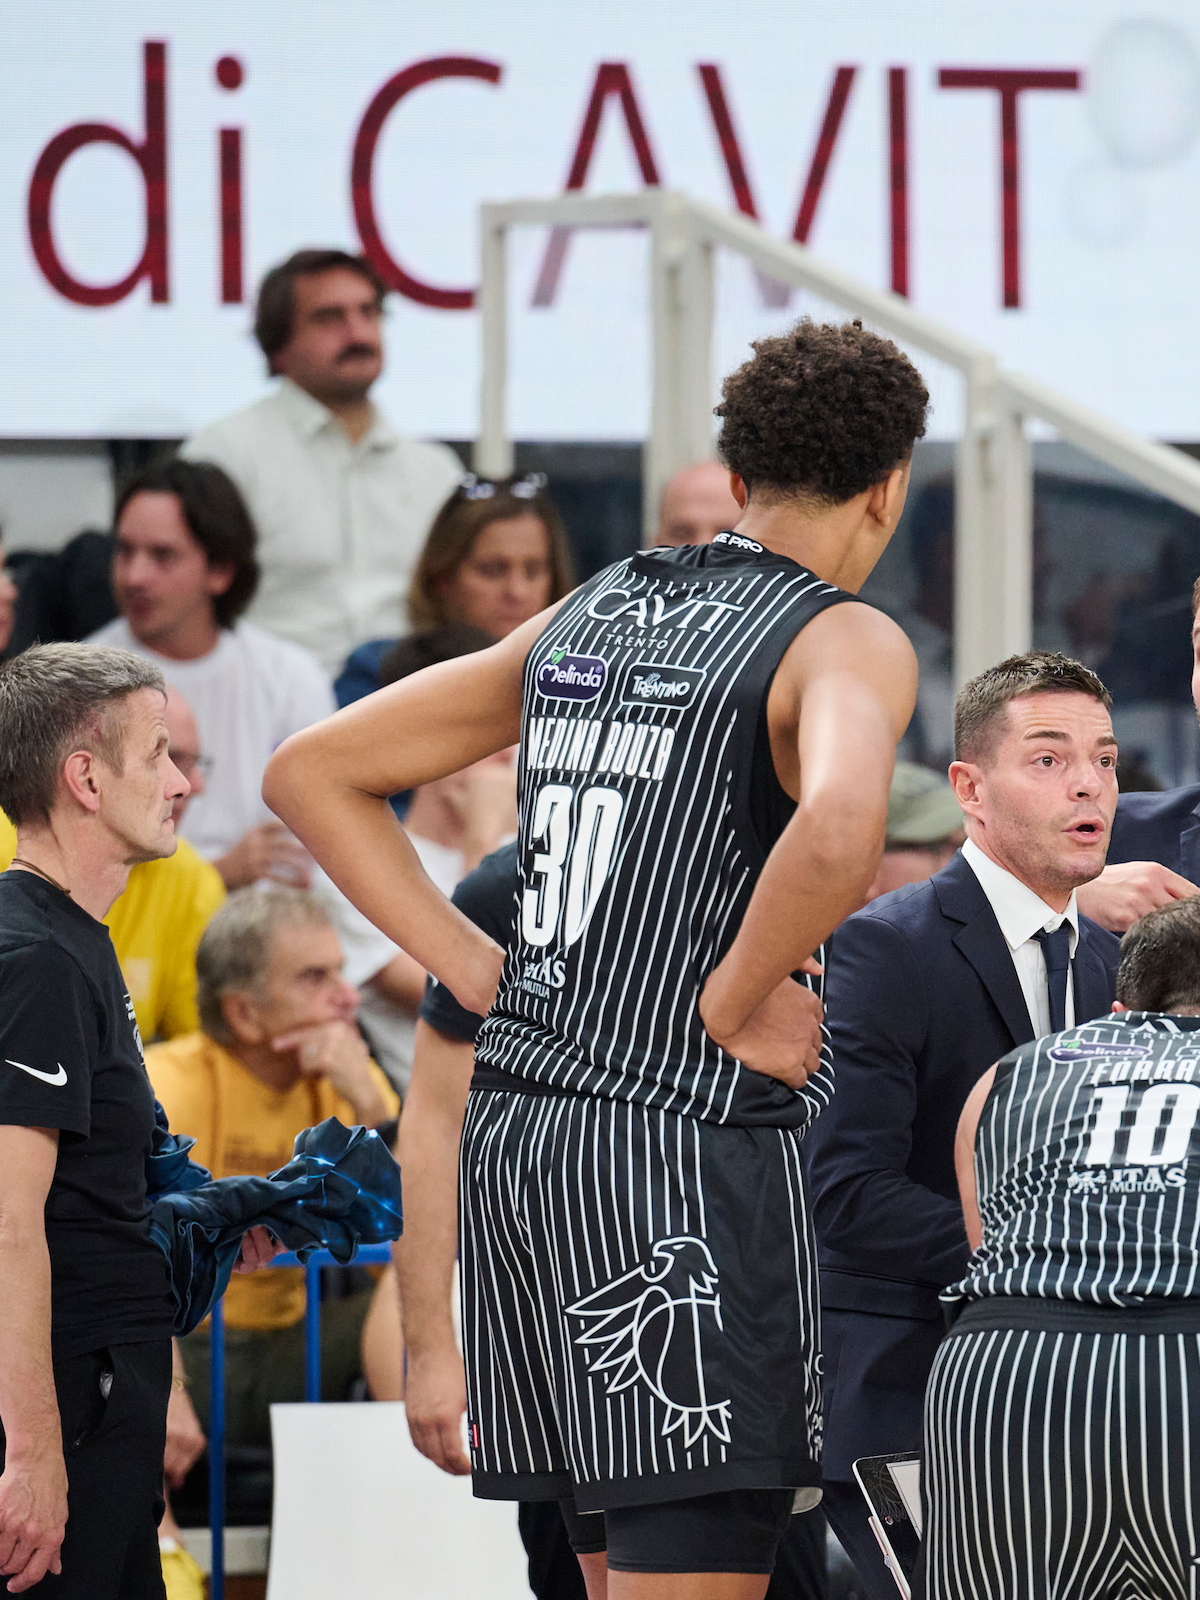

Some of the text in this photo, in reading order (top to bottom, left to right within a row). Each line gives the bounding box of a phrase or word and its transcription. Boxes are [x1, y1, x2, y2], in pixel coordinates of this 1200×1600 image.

[26, 39, 1084, 310] di CAVIT
[728, 535, 763, 553] PRO
[587, 588, 745, 633] CAVIT
[604, 633, 669, 650] TRENTO
[539, 663, 602, 688] Melinda
[632, 675, 691, 699] TRENTINO
[527, 717, 676, 780] MEDINA BOUZA
[522, 784, 623, 947] 30
[1109, 1181, 1167, 1194] MUTUA
[1112, 1167, 1188, 1188] ITAS
